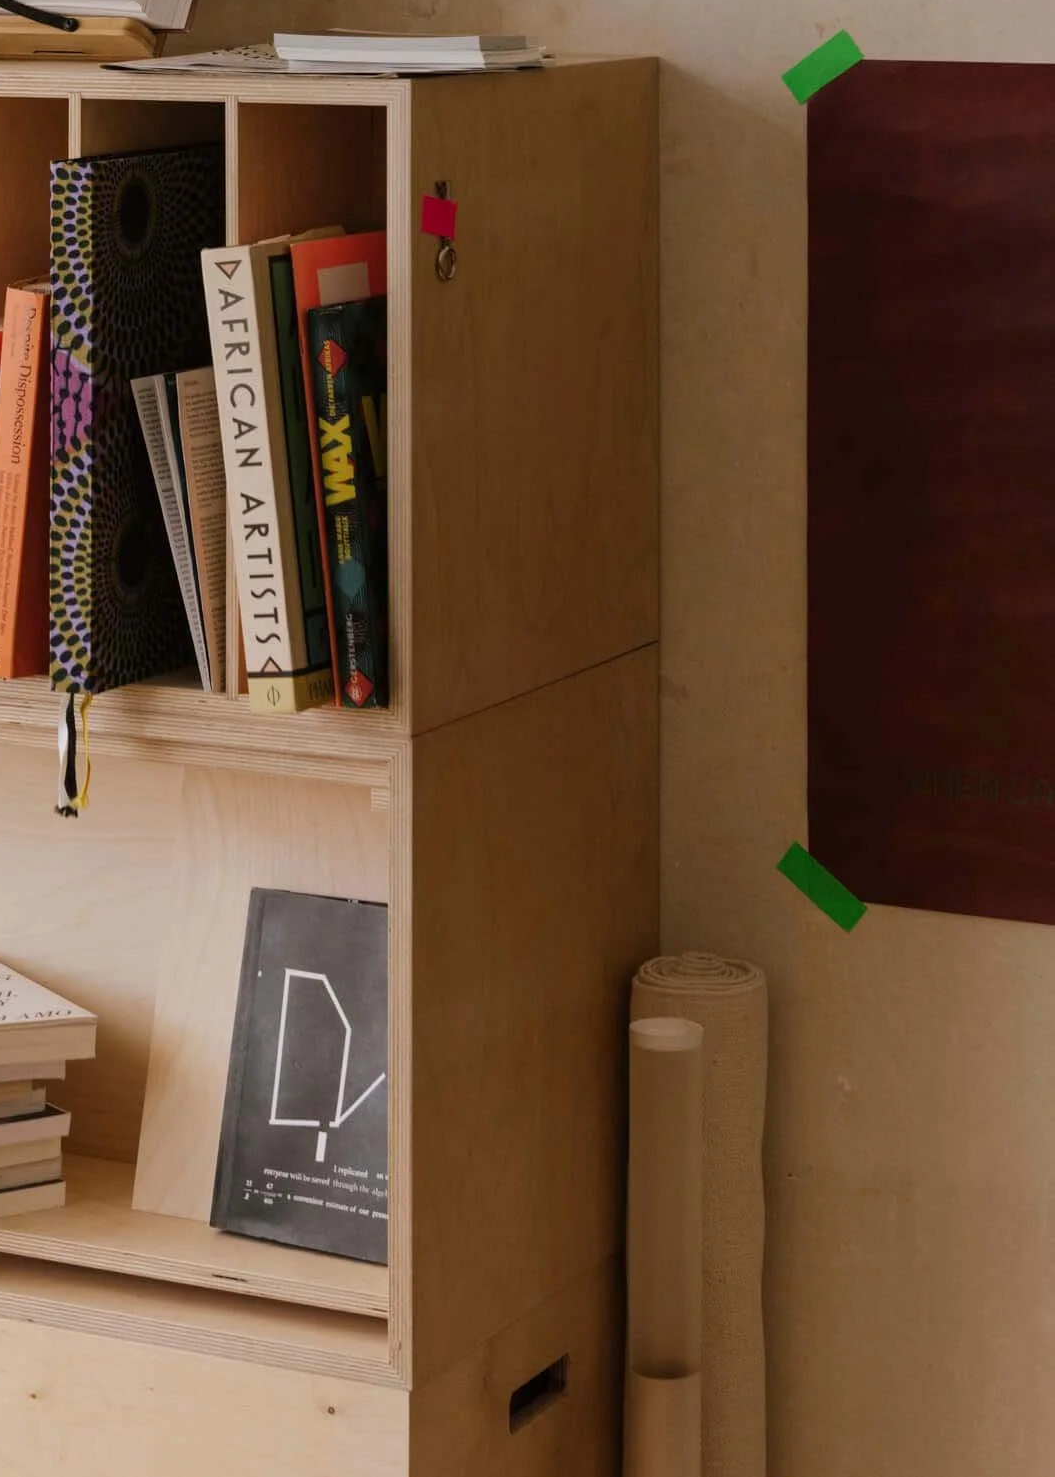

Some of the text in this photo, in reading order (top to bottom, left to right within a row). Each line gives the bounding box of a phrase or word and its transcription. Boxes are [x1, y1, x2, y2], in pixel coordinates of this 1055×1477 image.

[322, 339, 332, 372] AFRIKAS
[326, 373, 336, 402] FARBEN
[12, 364, 32, 464] Dispossession
[218, 288, 281, 644] AFRICAN ARTISTS
[319, 414, 356, 506] WAX
[346, 614, 358, 682] GERSTENBERG
[22, 1010, 73, 1020] AMO
[290, 1172, 302, 1180] will
[303, 1174, 310, 1182] be
[332, 1179, 358, 1193] through
